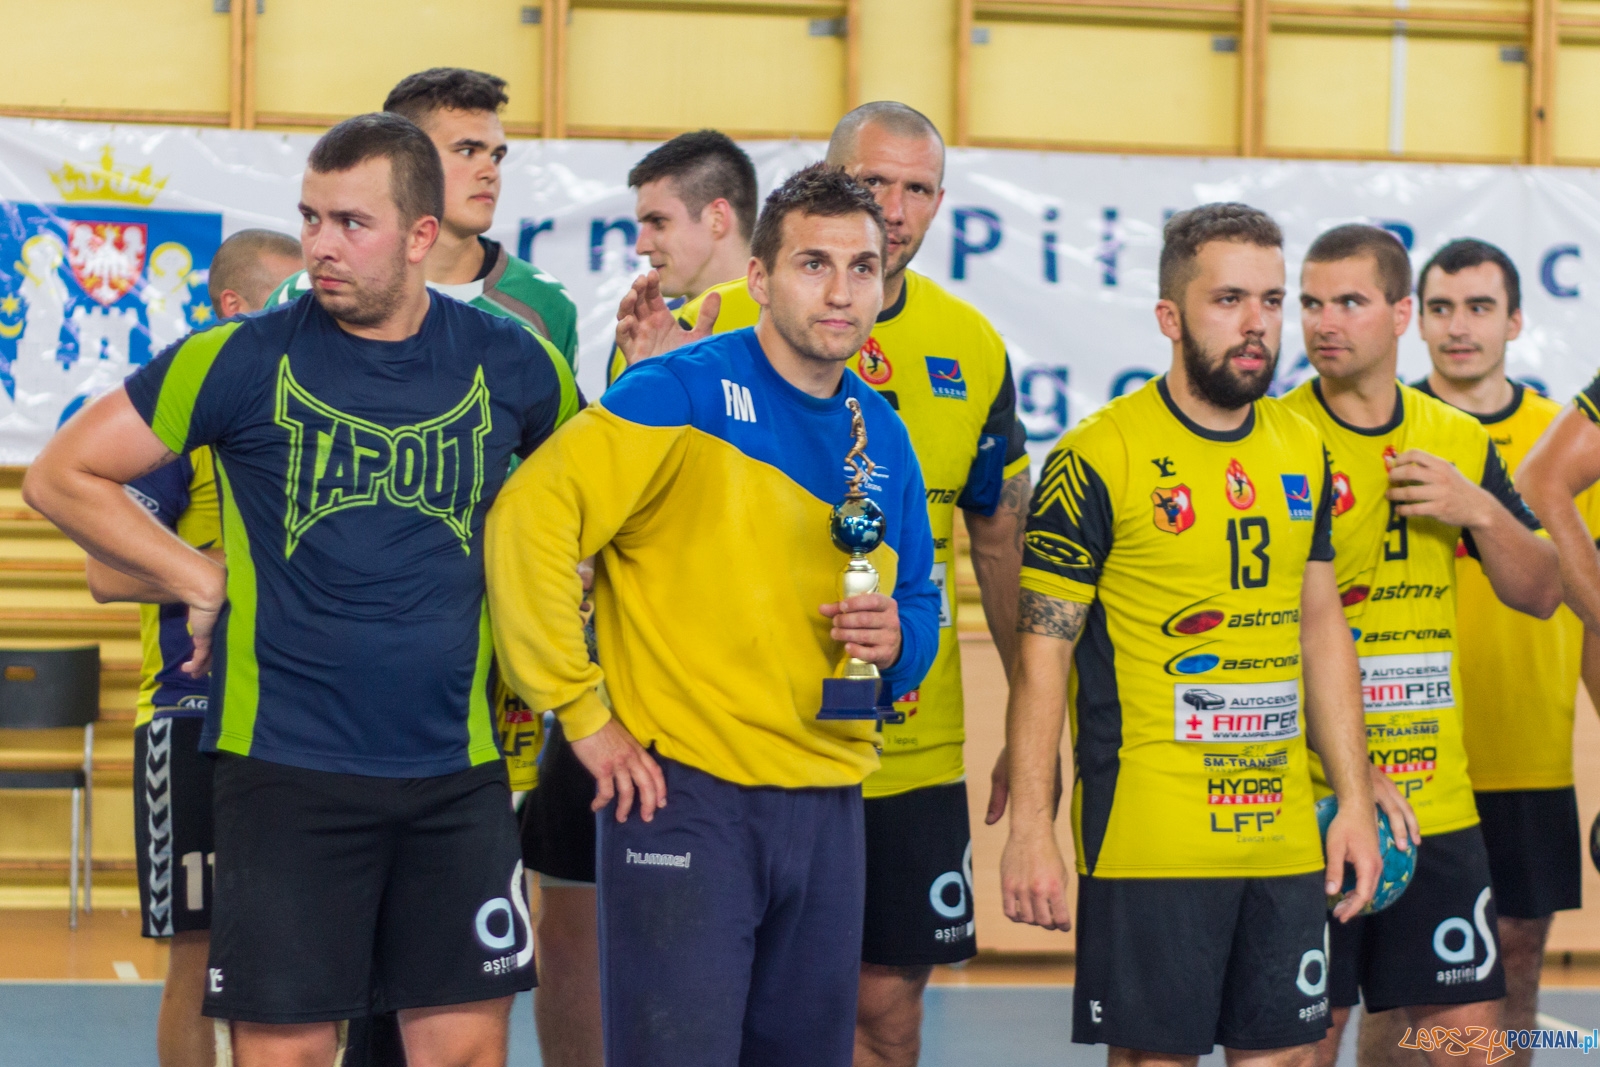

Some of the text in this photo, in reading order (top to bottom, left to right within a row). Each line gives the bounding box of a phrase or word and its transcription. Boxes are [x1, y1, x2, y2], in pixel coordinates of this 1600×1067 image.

[720, 378, 758, 424] FM
[275, 353, 492, 561] TAPOUT
[1226, 516, 1271, 590] 13
[1227, 609, 1299, 628] astroma
[1362, 681, 1451, 702] AMPER
[1213, 710, 1298, 731] AMPER
[502, 730, 536, 756] LF
[1385, 762, 1435, 774] RTNER
[1208, 777, 1283, 795] HYDRO
[1210, 794, 1282, 805] PARTNER
[1210, 811, 1275, 833] LFP
[626, 847, 692, 869] hummel
